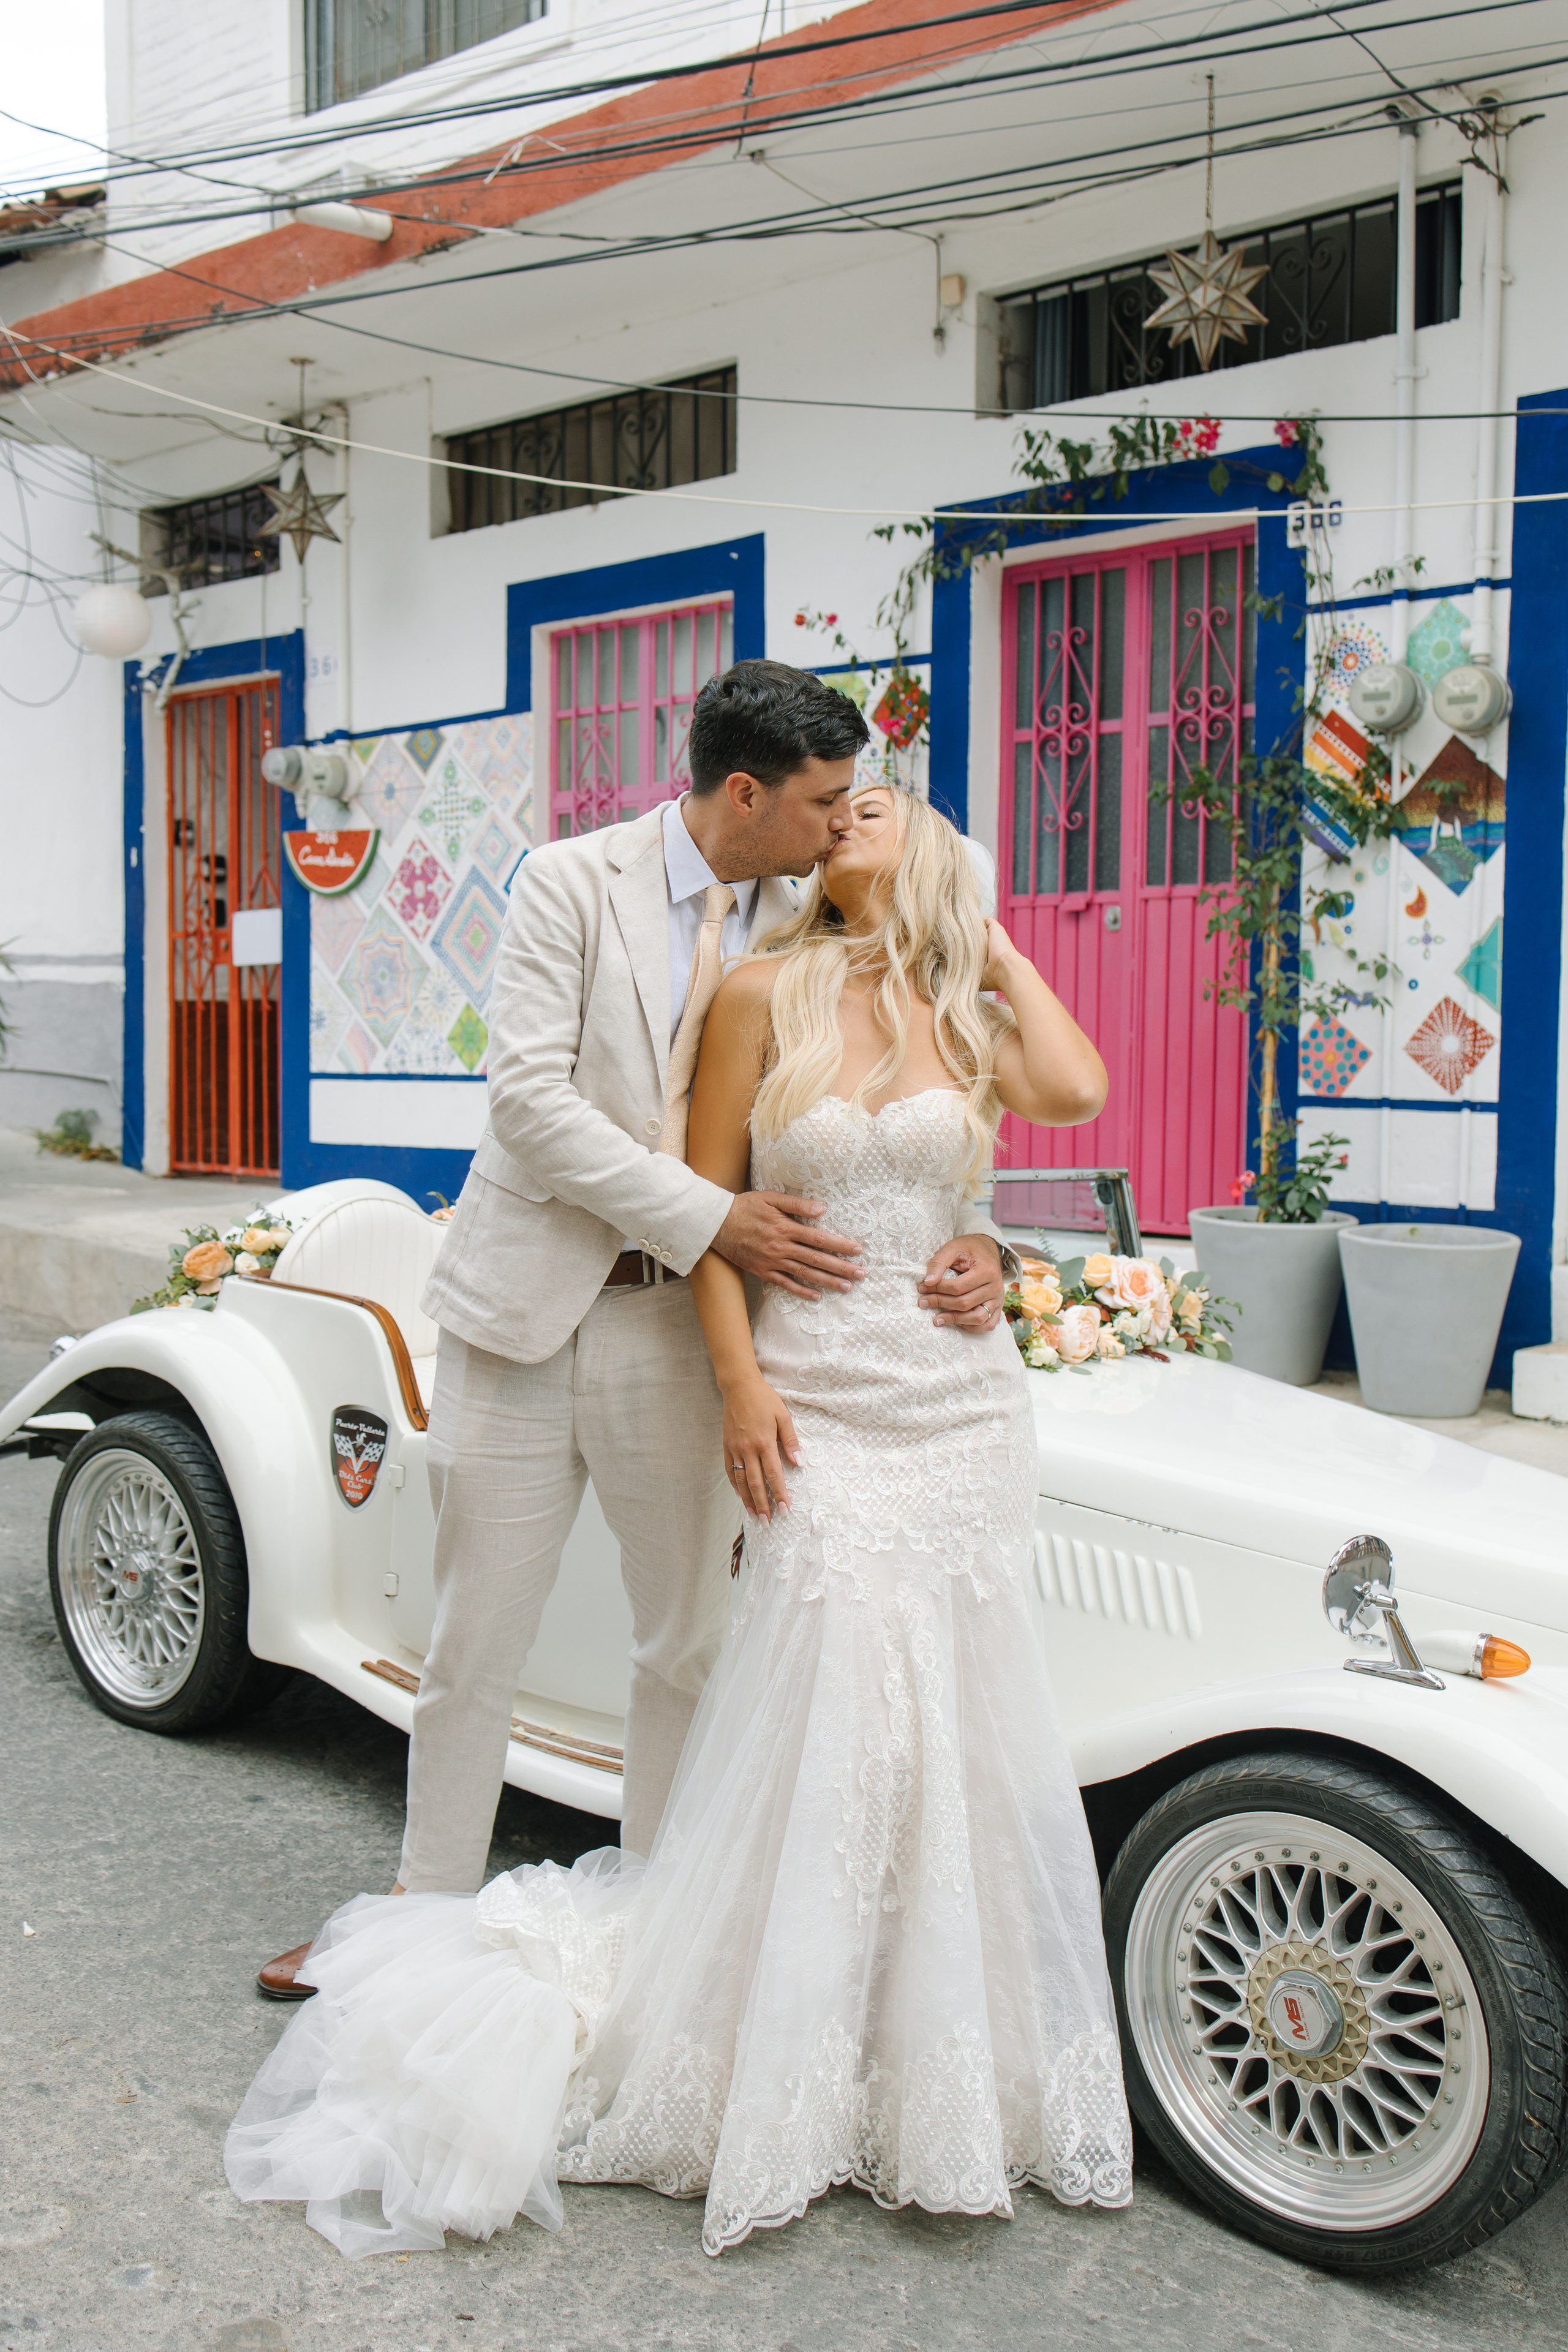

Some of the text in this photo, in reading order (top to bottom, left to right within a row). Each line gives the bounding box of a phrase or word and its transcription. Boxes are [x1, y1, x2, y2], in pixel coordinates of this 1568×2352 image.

[347, 1480, 364, 1490] Club
[345, 1490, 363, 1500] 2010
[1373, 1821, 1409, 1850] ROTATION
[1283, 1996, 1306, 2041] MS
